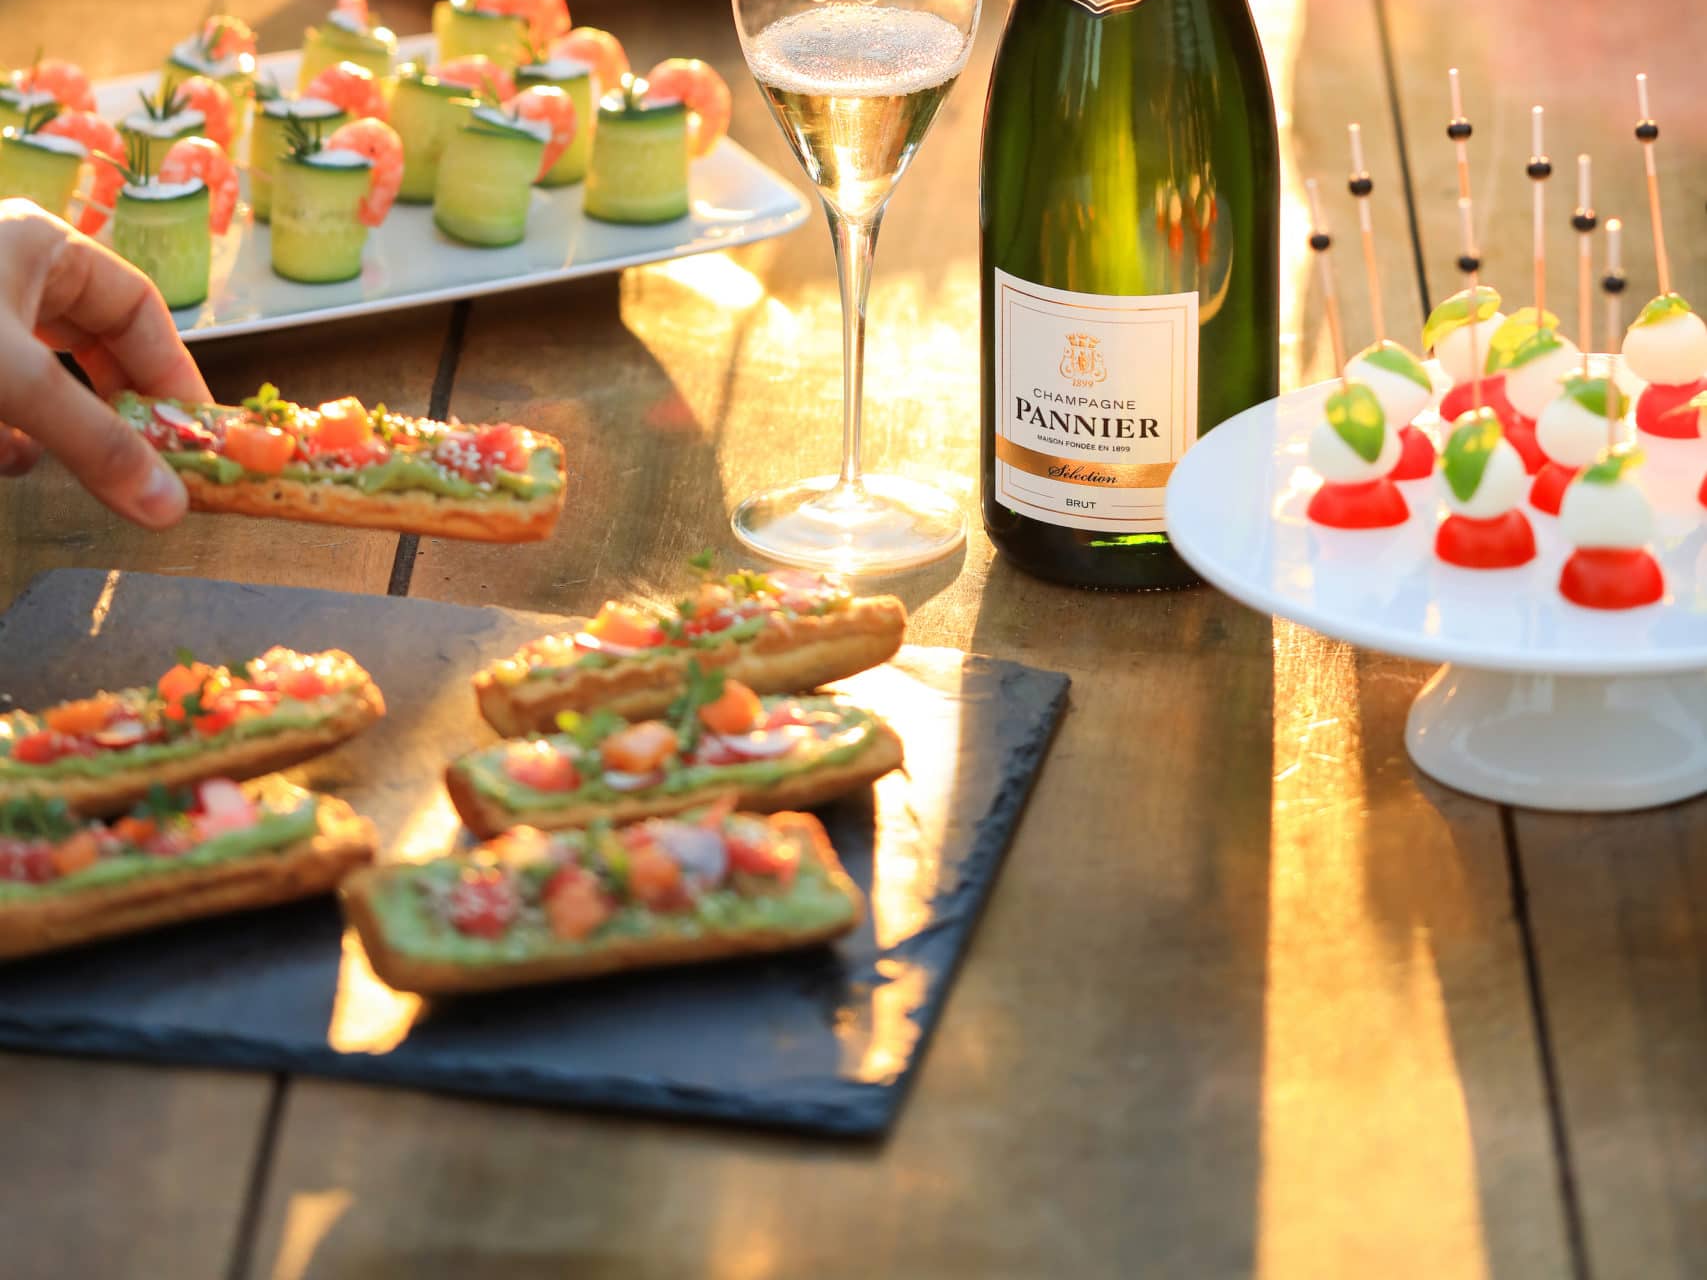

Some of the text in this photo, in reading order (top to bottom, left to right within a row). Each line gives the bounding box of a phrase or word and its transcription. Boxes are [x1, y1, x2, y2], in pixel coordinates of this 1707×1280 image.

[1072, 379, 1094, 388] 1899
[1033, 388, 1136, 410] CHAMPAGNE
[1015, 396, 1160, 439] PANNIER
[1037, 434, 1131, 453] MAISON FONDÉE EN 1899
[1065, 498, 1096, 510] BRUT
